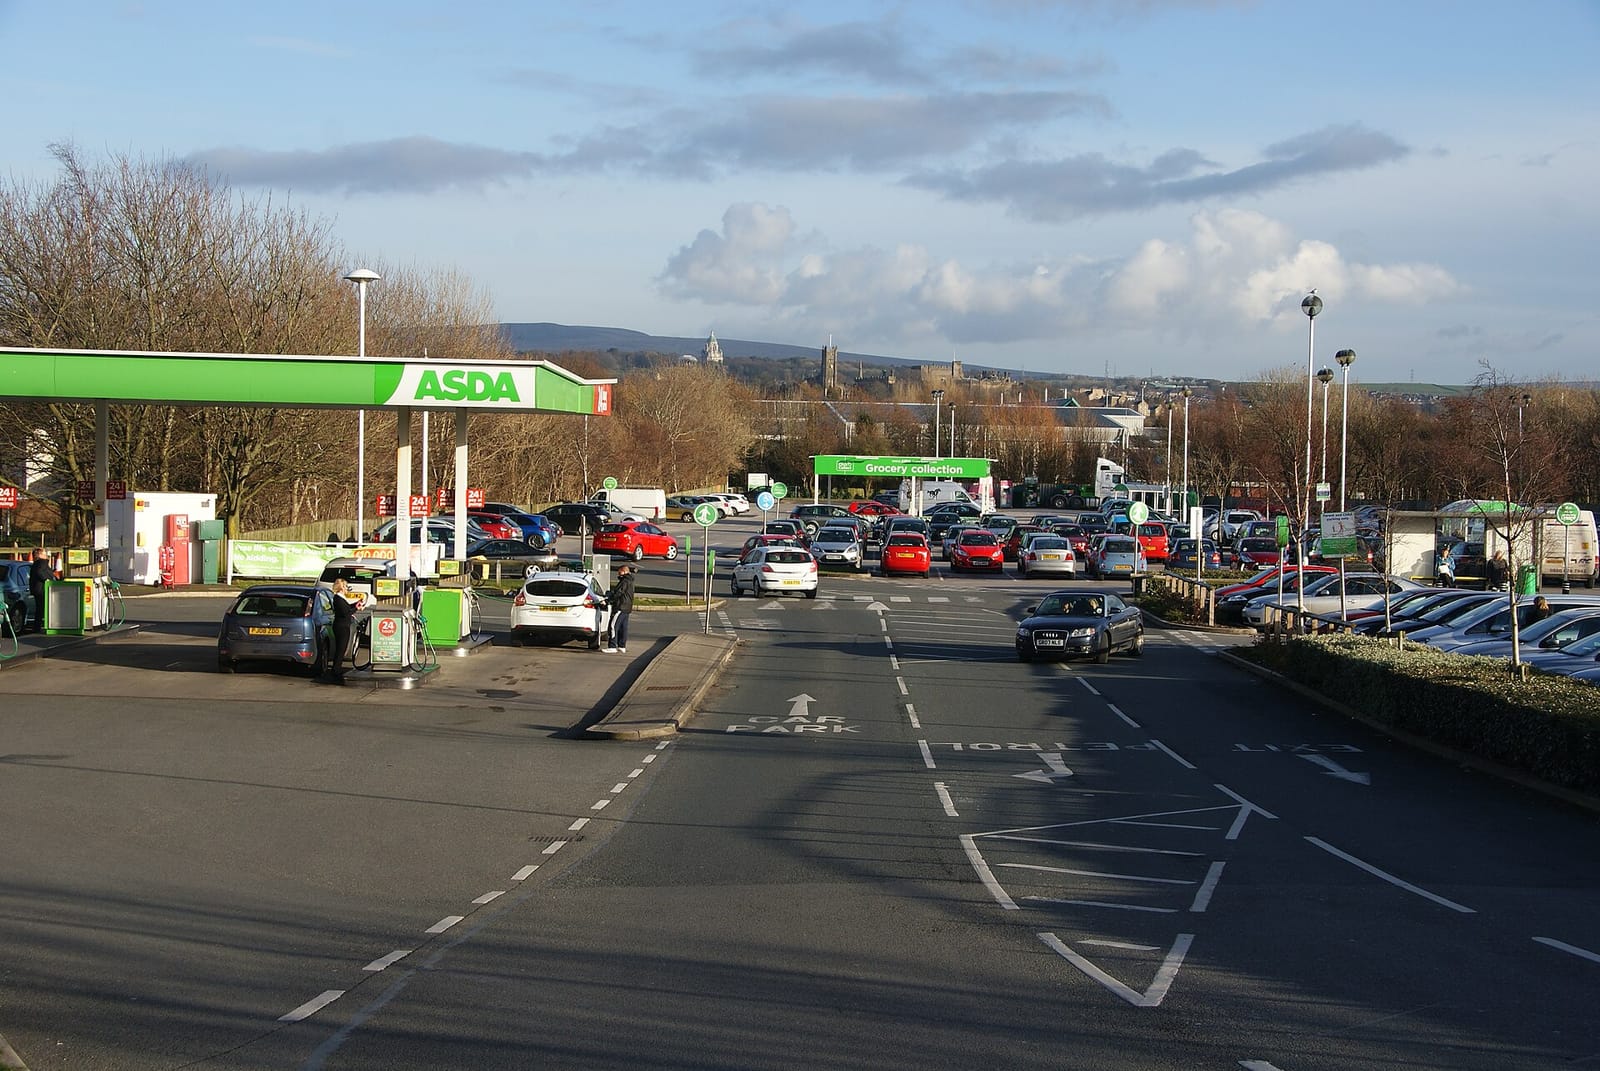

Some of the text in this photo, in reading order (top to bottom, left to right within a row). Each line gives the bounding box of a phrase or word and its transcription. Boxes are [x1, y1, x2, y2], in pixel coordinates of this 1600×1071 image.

[414, 370, 520, 402] ASDA
[865, 463, 907, 475] Grocery
[911, 464, 963, 475] collection
[80, 481, 91, 489] 24
[109, 482, 121, 490] 24
[0, 487, 12, 497] 24
[468, 490, 480, 498] 24
[379, 496, 391, 505] 24
[411, 497, 424, 506] 24
[381, 621, 395, 629] 24
[748, 715, 846, 723] CAR
[726, 724, 861, 733] PARK
[928, 742, 1158, 751] PETROL
[1231, 743, 1364, 753] EXIT
